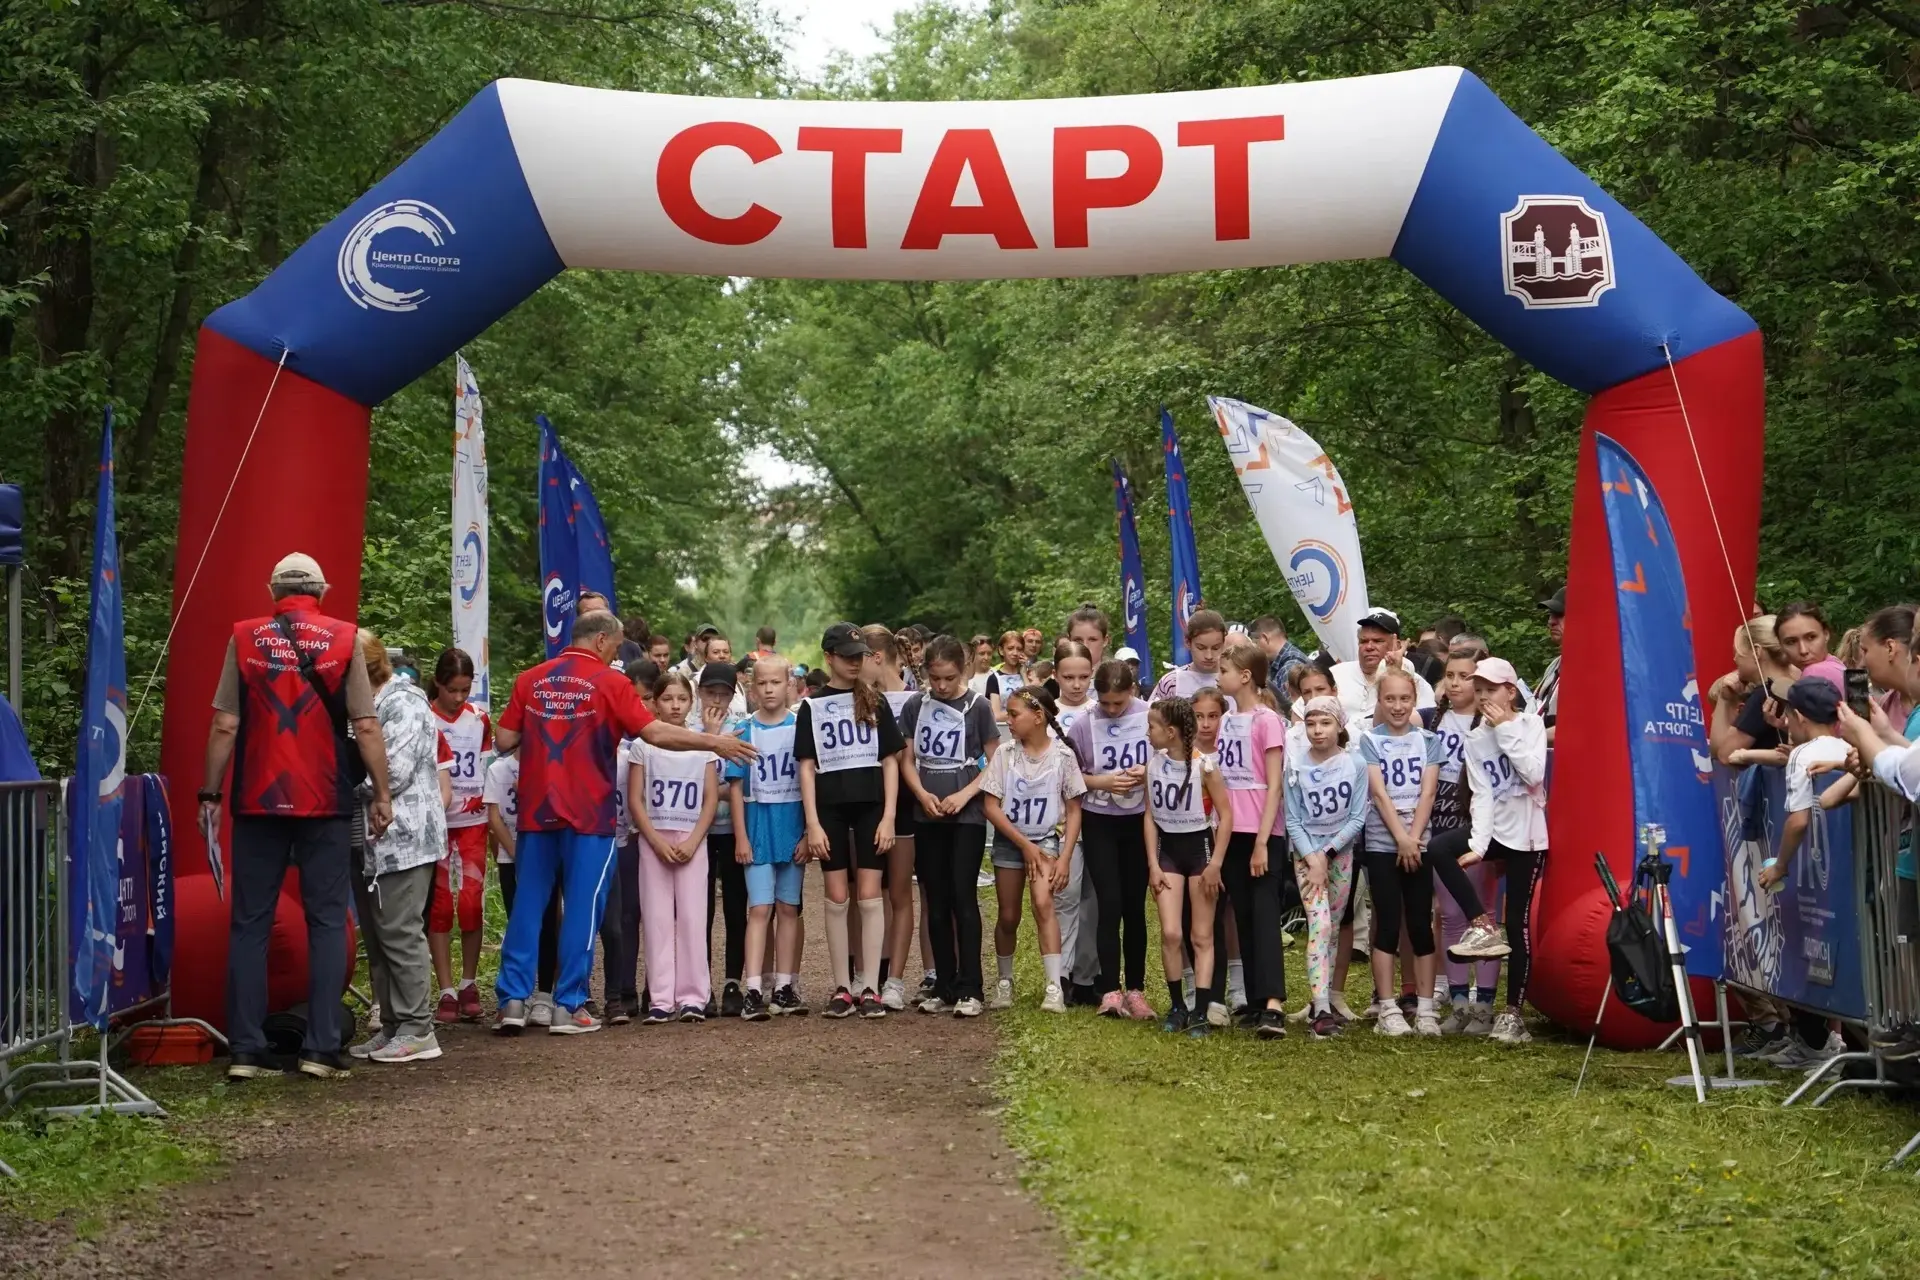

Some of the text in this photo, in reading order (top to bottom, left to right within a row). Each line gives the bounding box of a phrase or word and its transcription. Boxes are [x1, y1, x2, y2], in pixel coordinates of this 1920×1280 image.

[656, 115, 1285, 250] СТАРТ
[371, 262, 436, 272] Красногвардейского
[372, 251, 461, 266] Центр Спорта
[553, 590, 571, 608] ЦЕНТР
[560, 600, 576, 613] СПОРТ
[255, 637, 330, 651] СПОРТВНАЯ
[271, 649, 300, 660] ШКО
[533, 675, 596, 691] САНКТ-ПЕТЕРБУРГ
[533, 690, 591, 701] СПОРТИВНАЯ
[545, 701, 576, 710] ШКОЛА
[821, 719, 872, 750] 300
[919, 726, 961, 758] 367
[449, 750, 475, 778] 33
[757, 752, 796, 782] 314
[1102, 740, 1148, 771] 360
[1218, 738, 1244, 768] 361
[1483, 753, 1511, 788] 30
[652, 779, 698, 810] 370
[1308, 781, 1352, 818] 339
[1006, 797, 1048, 825] 317
